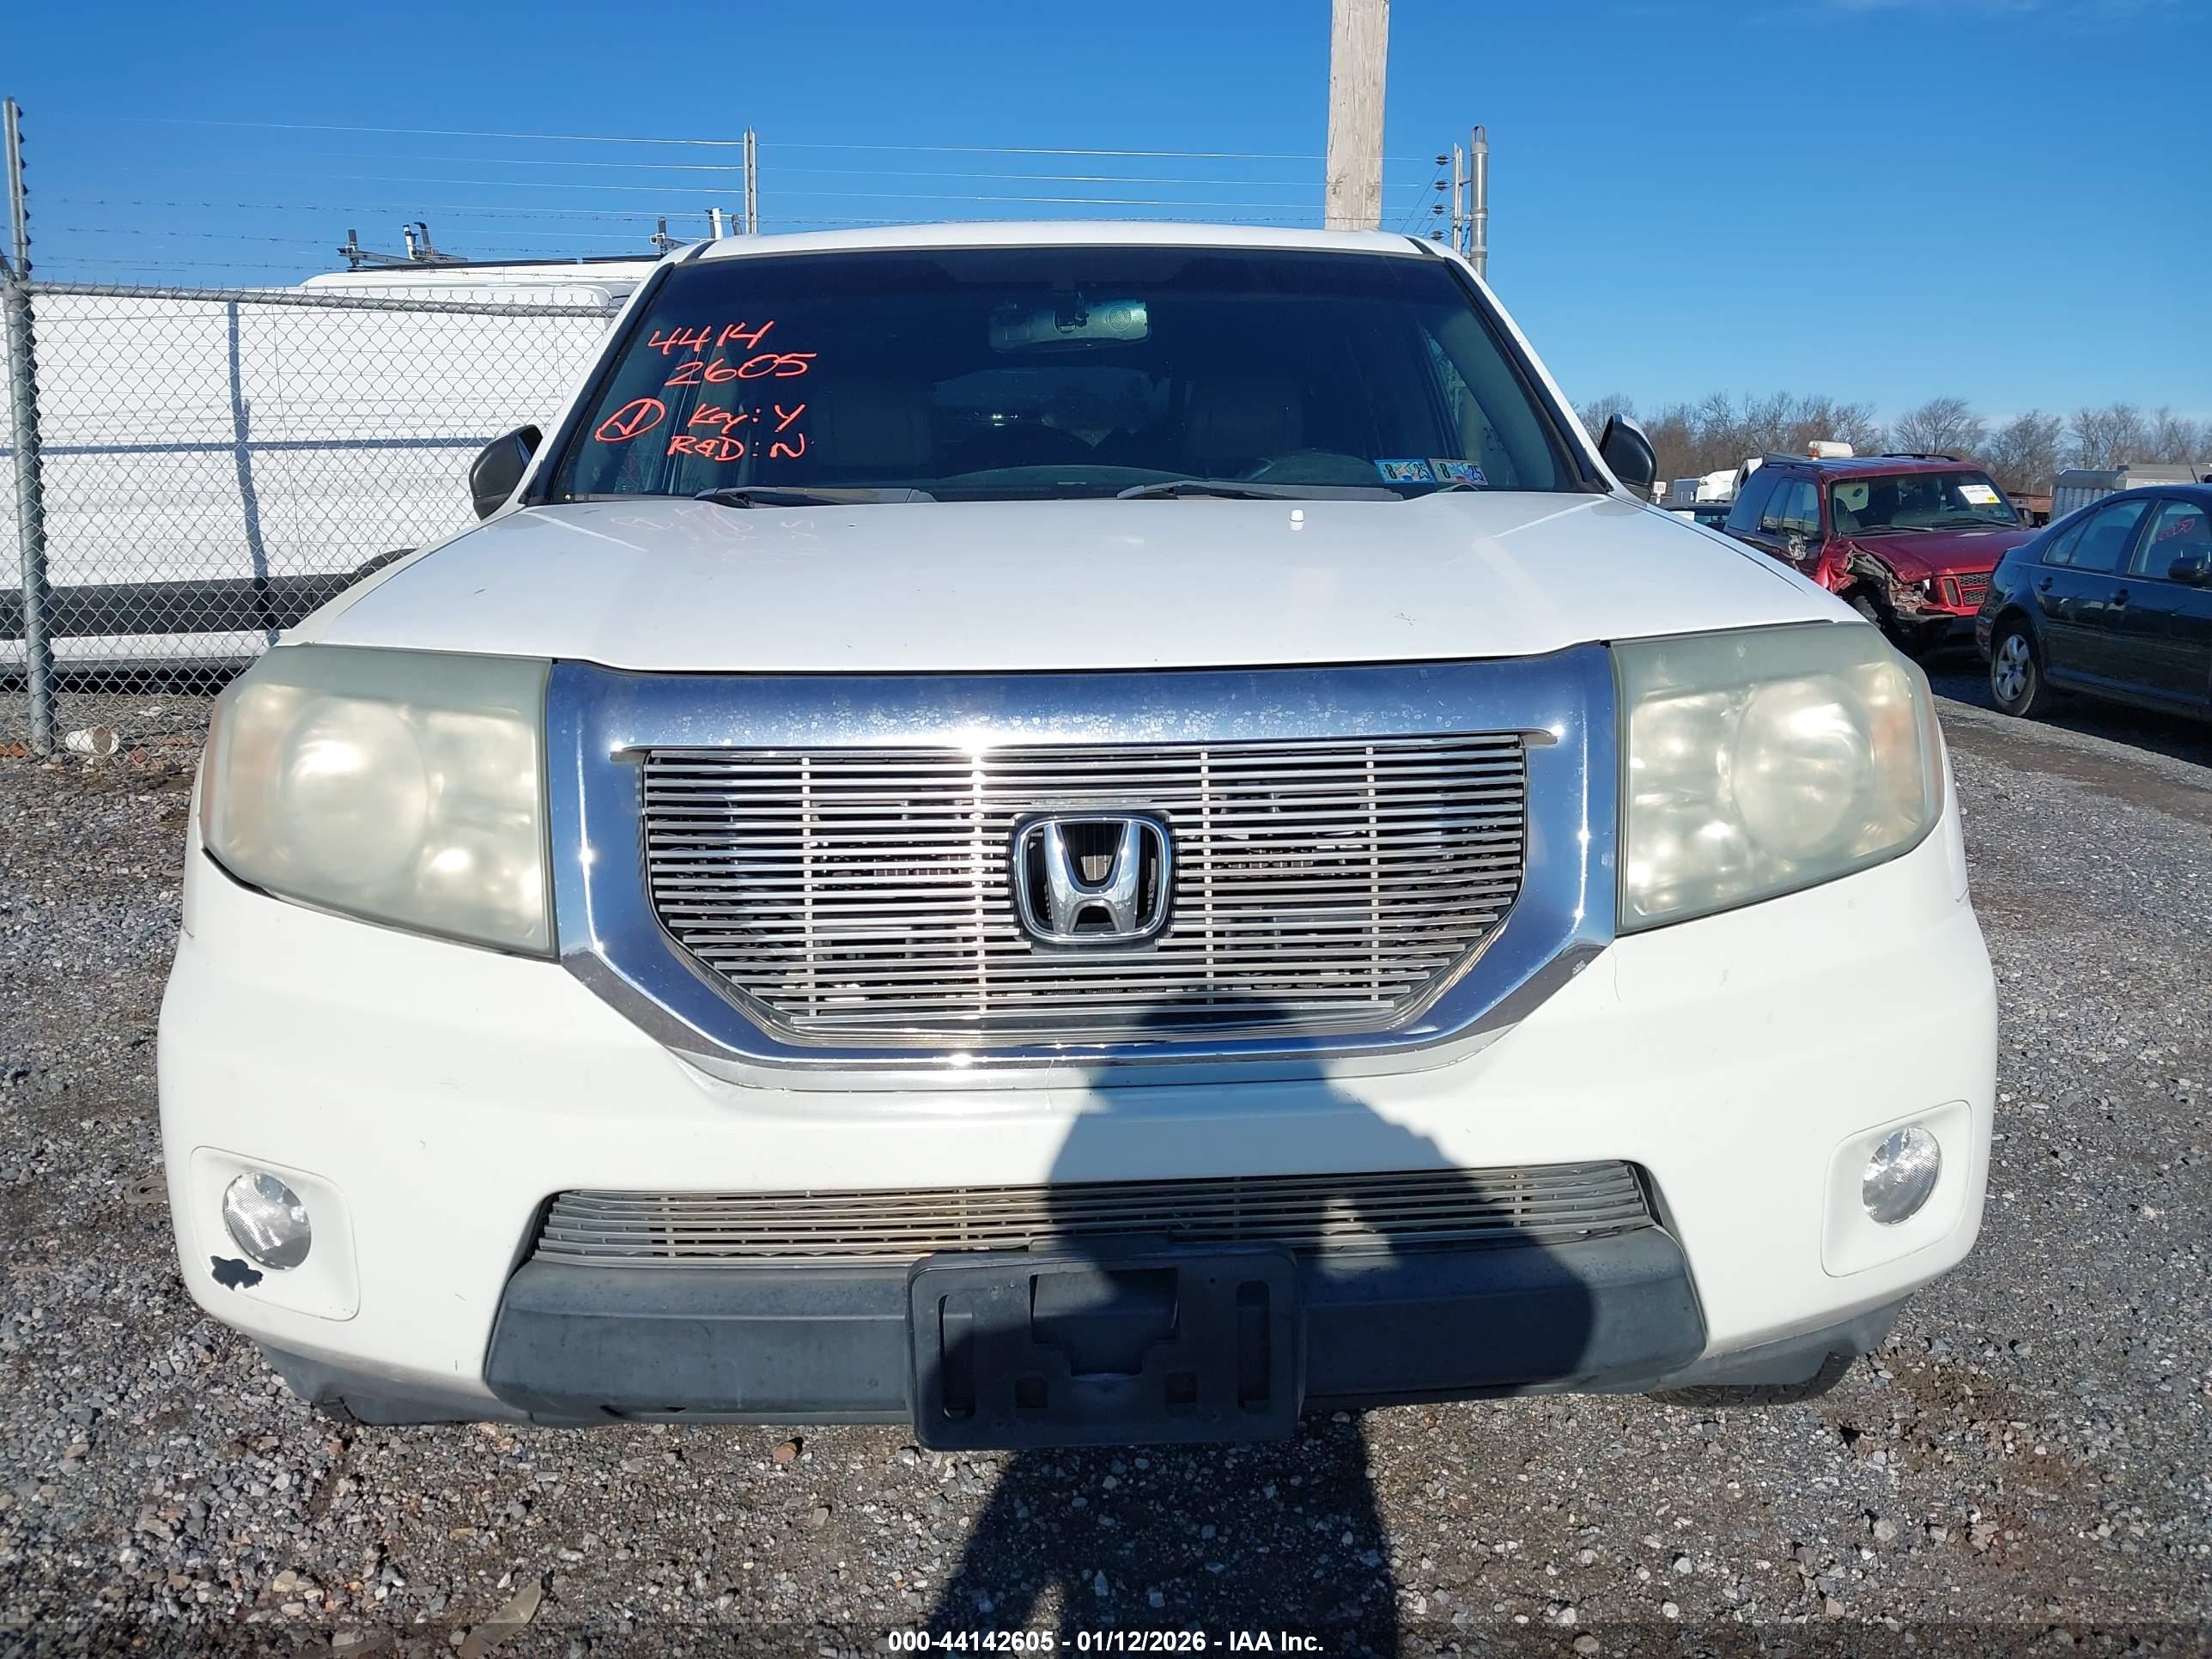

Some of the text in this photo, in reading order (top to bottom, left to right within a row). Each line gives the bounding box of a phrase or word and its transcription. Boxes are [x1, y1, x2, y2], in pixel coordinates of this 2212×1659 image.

[648, 320, 775, 355] 4414
[665, 353, 817, 386] 2605
[1385, 463, 1398, 480] 8
[1439, 462, 1451, 479] 8
